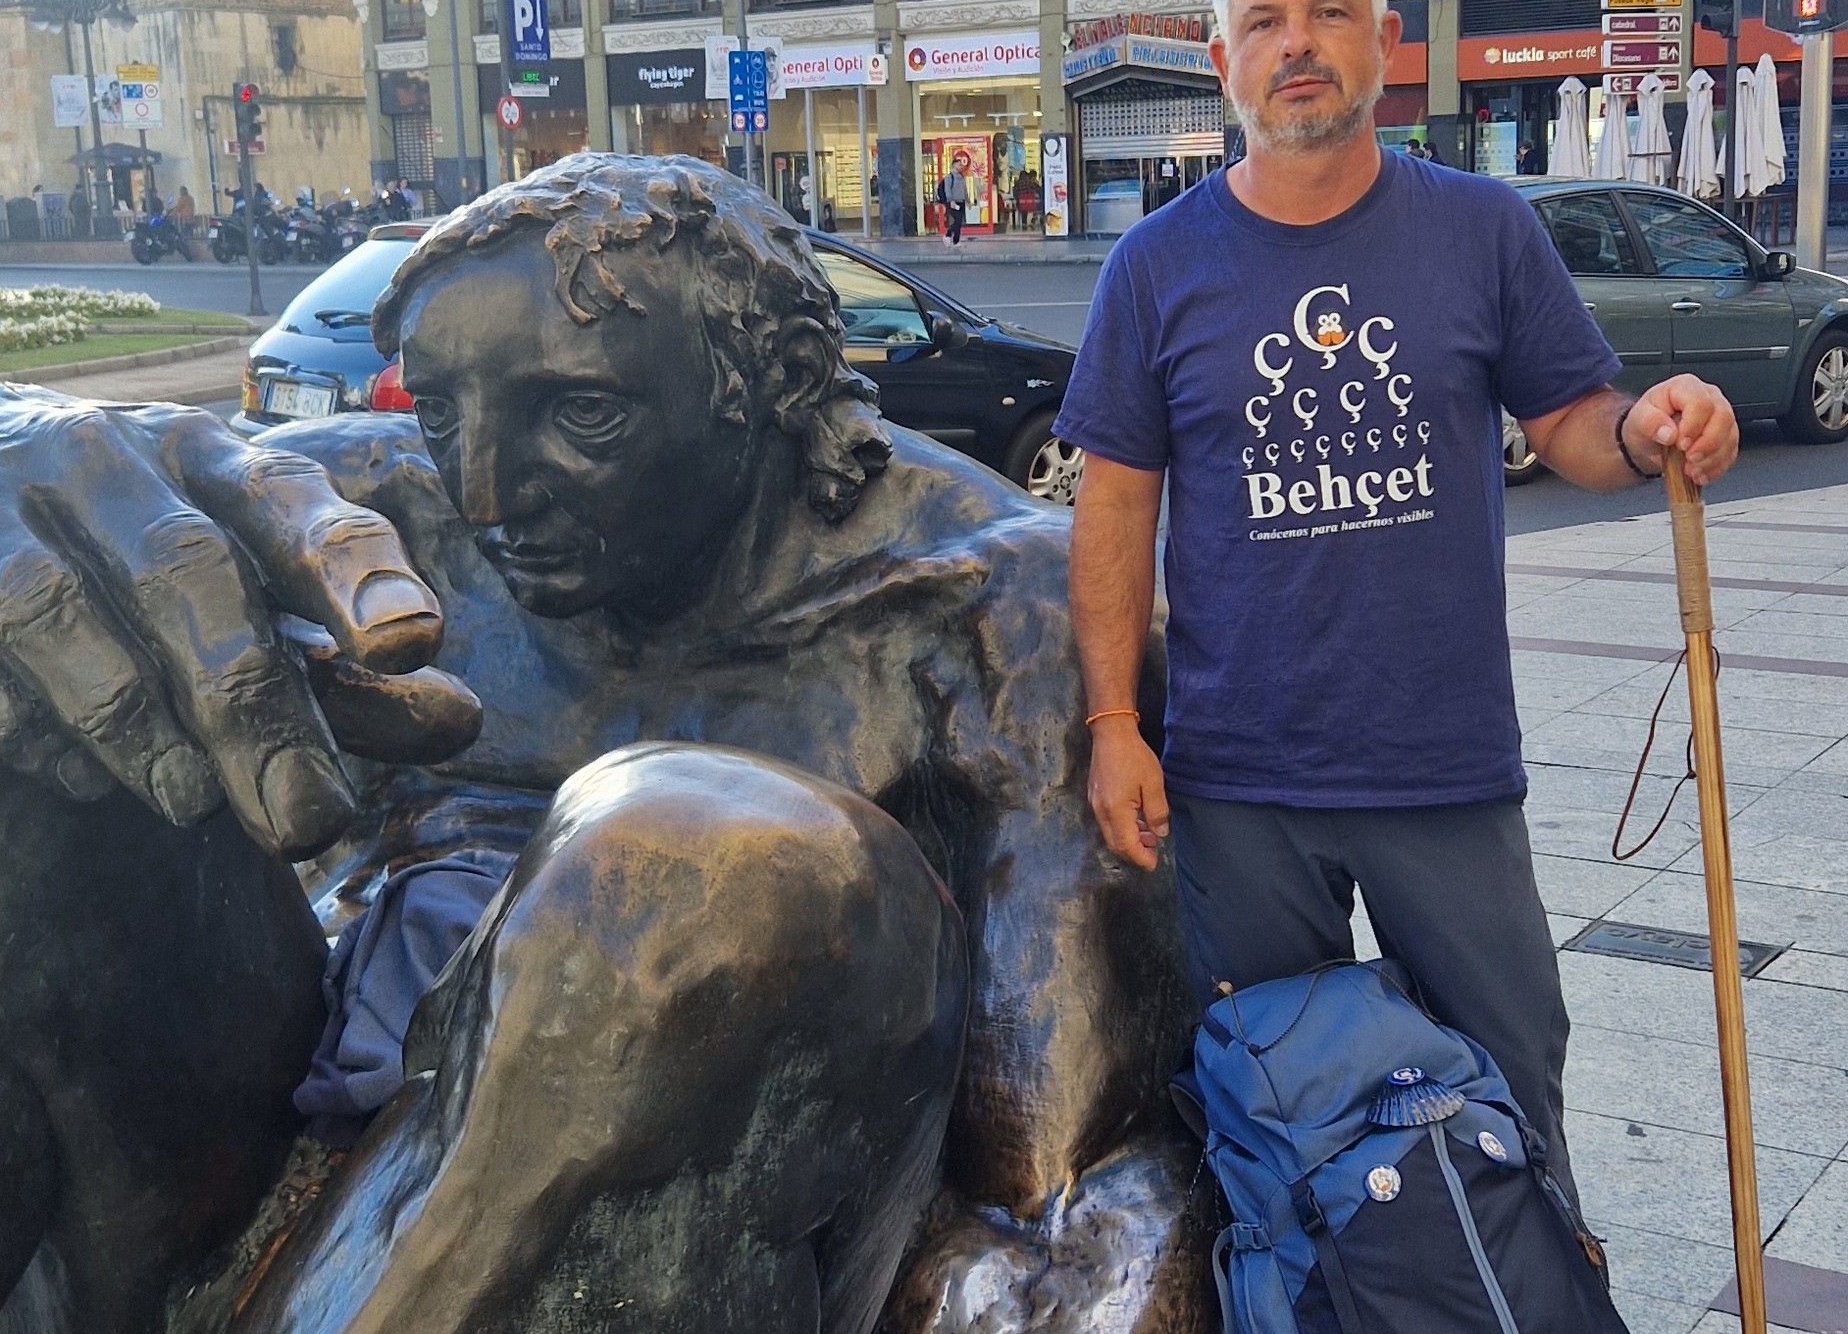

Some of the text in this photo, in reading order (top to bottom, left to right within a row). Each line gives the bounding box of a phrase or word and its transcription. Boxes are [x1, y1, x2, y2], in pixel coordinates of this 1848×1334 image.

[1611, 20, 1636, 28] catedral
[520, 42, 542, 51] SANTO
[932, 43, 1040, 64] General Optica
[1503, 46, 1597, 63] luckia sport café
[515, 52, 549, 61] DOMINGO
[638, 65, 695, 82] flying tiger
[783, 57, 830, 74] eneral
[1242, 453, 1434, 519] Behçet
[1250, 509, 1435, 541] Conócenos para hacernos visibles
